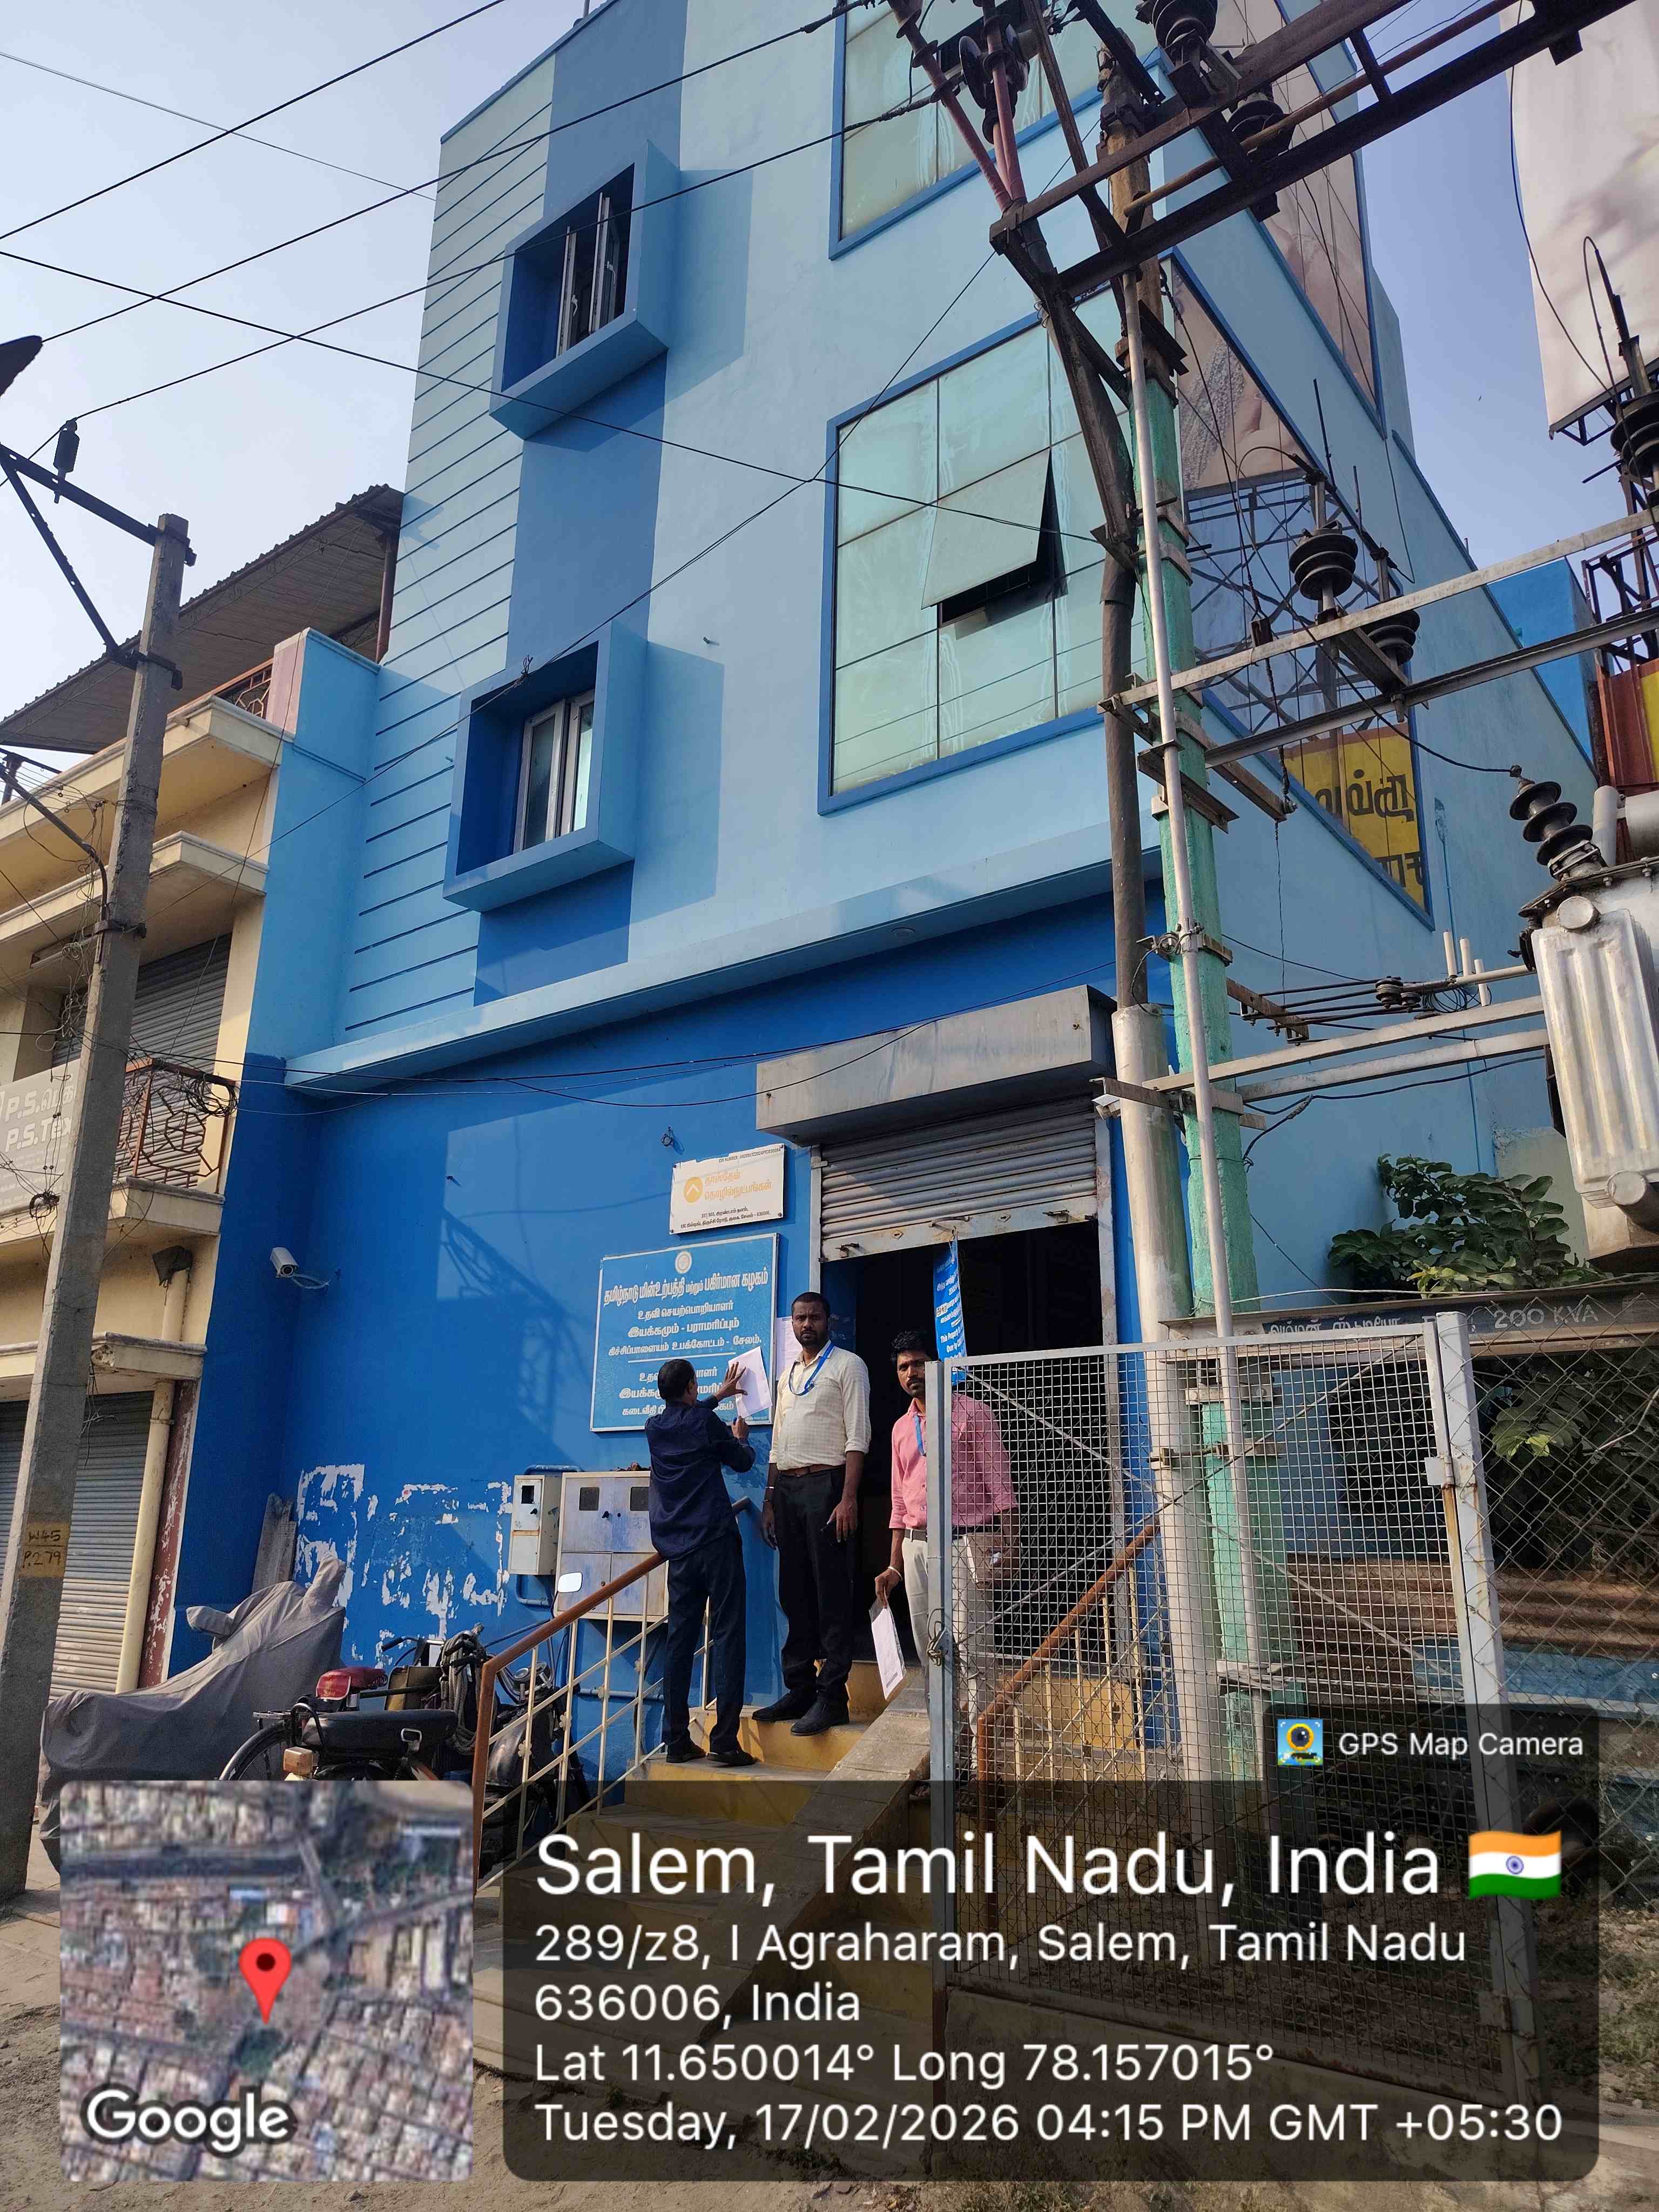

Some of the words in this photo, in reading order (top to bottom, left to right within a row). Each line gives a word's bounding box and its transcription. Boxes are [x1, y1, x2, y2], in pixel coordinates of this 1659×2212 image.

[603, 1284, 639, 1307] தமிழ்நாடு
[686, 1280, 704, 1295] மற்றும்
[705, 1272, 740, 1291] பகிர்மான
[742, 1267, 768, 1292] கழகம்
[638, 1308, 660, 1321] உதவி
[662, 1299, 734, 1318] செயற்பொறியாளர்
[1493, 1309, 1545, 1329] 200
[1554, 1304, 1599, 1325] KVA
[628, 1323, 679, 1338] இயக்கமும்
[686, 1317, 739, 1333] பராமரிப்பும்
[608, 1342, 669, 1357] கிச்சிப்பாளையம்
[672, 1337, 725, 1351] உபக்கோட்டம்
[733, 1333, 761, 1346] சேலம்.
